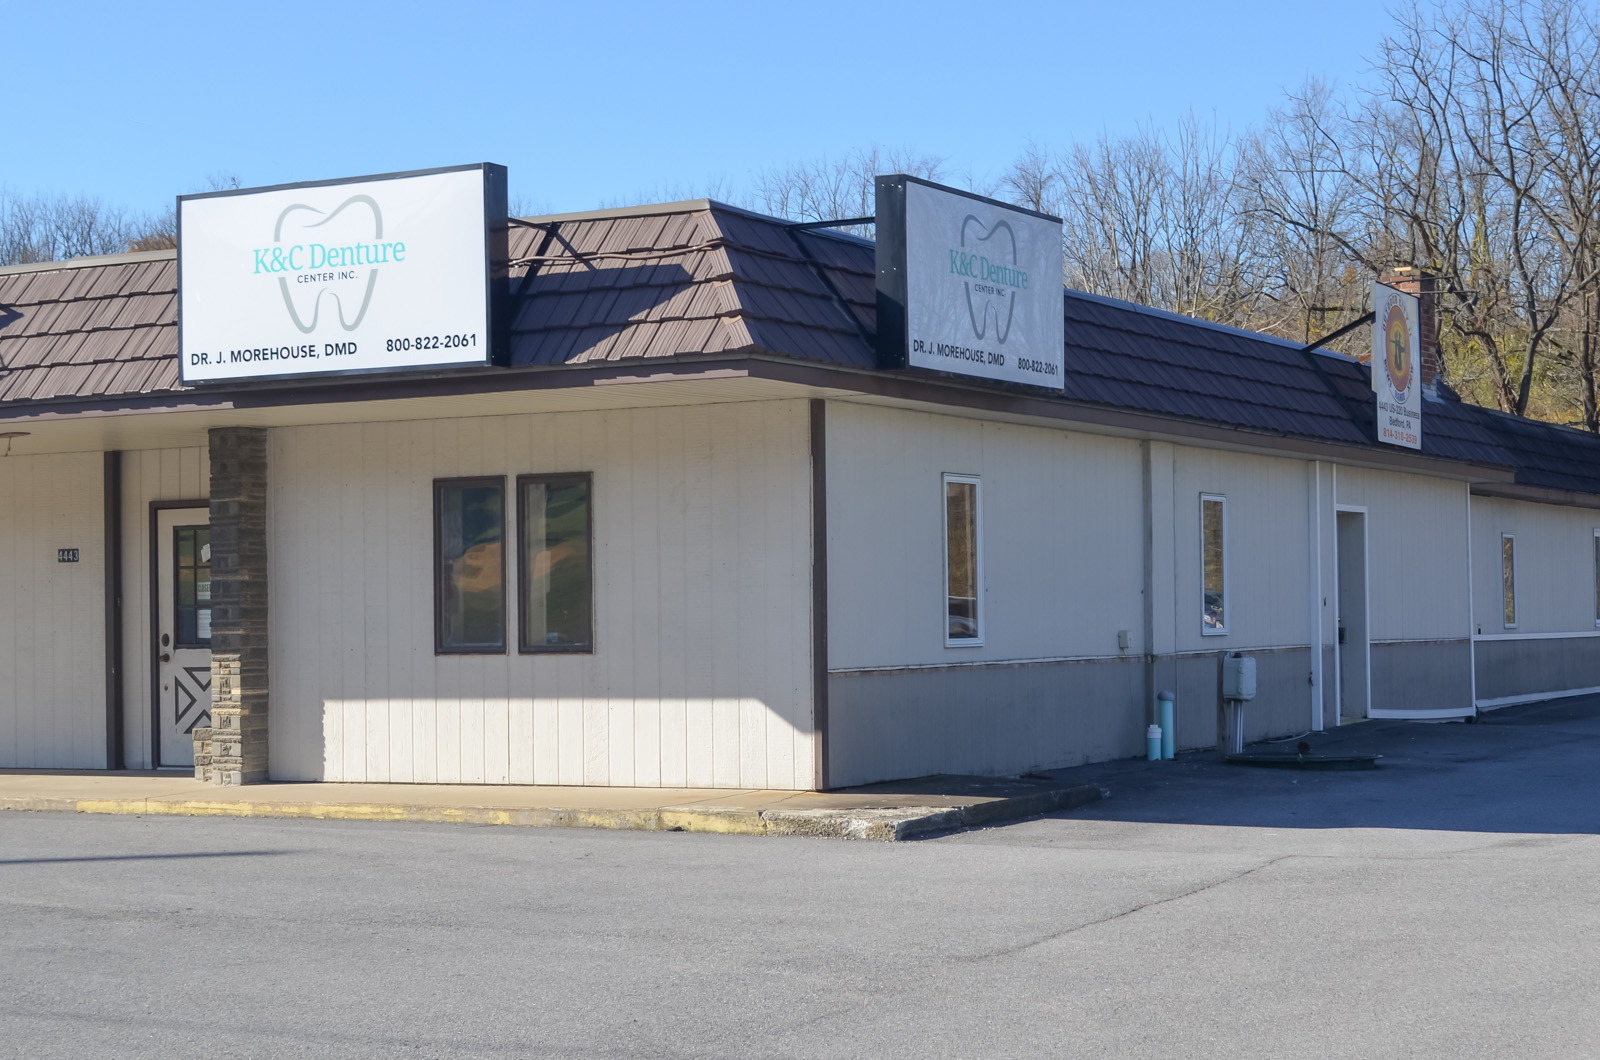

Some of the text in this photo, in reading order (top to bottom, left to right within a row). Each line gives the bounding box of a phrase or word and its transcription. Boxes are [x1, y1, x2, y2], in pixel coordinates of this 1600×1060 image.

[253, 241, 406, 274] K&C Denture
[297, 270, 358, 284] CENTER INC.
[950, 249, 1028, 289] K&C Denture
[974, 284, 1006, 297] CENTER INC.
[386, 334, 477, 352] 800-822-2061
[913, 339, 1005, 366] DR. J. MOREHOUSE, DMD
[190, 342, 358, 366] DR. J. MOREHOUSE, DMD
[1017, 357, 1059, 376] 800-822-2061
[58, 550, 79, 561] 4443
